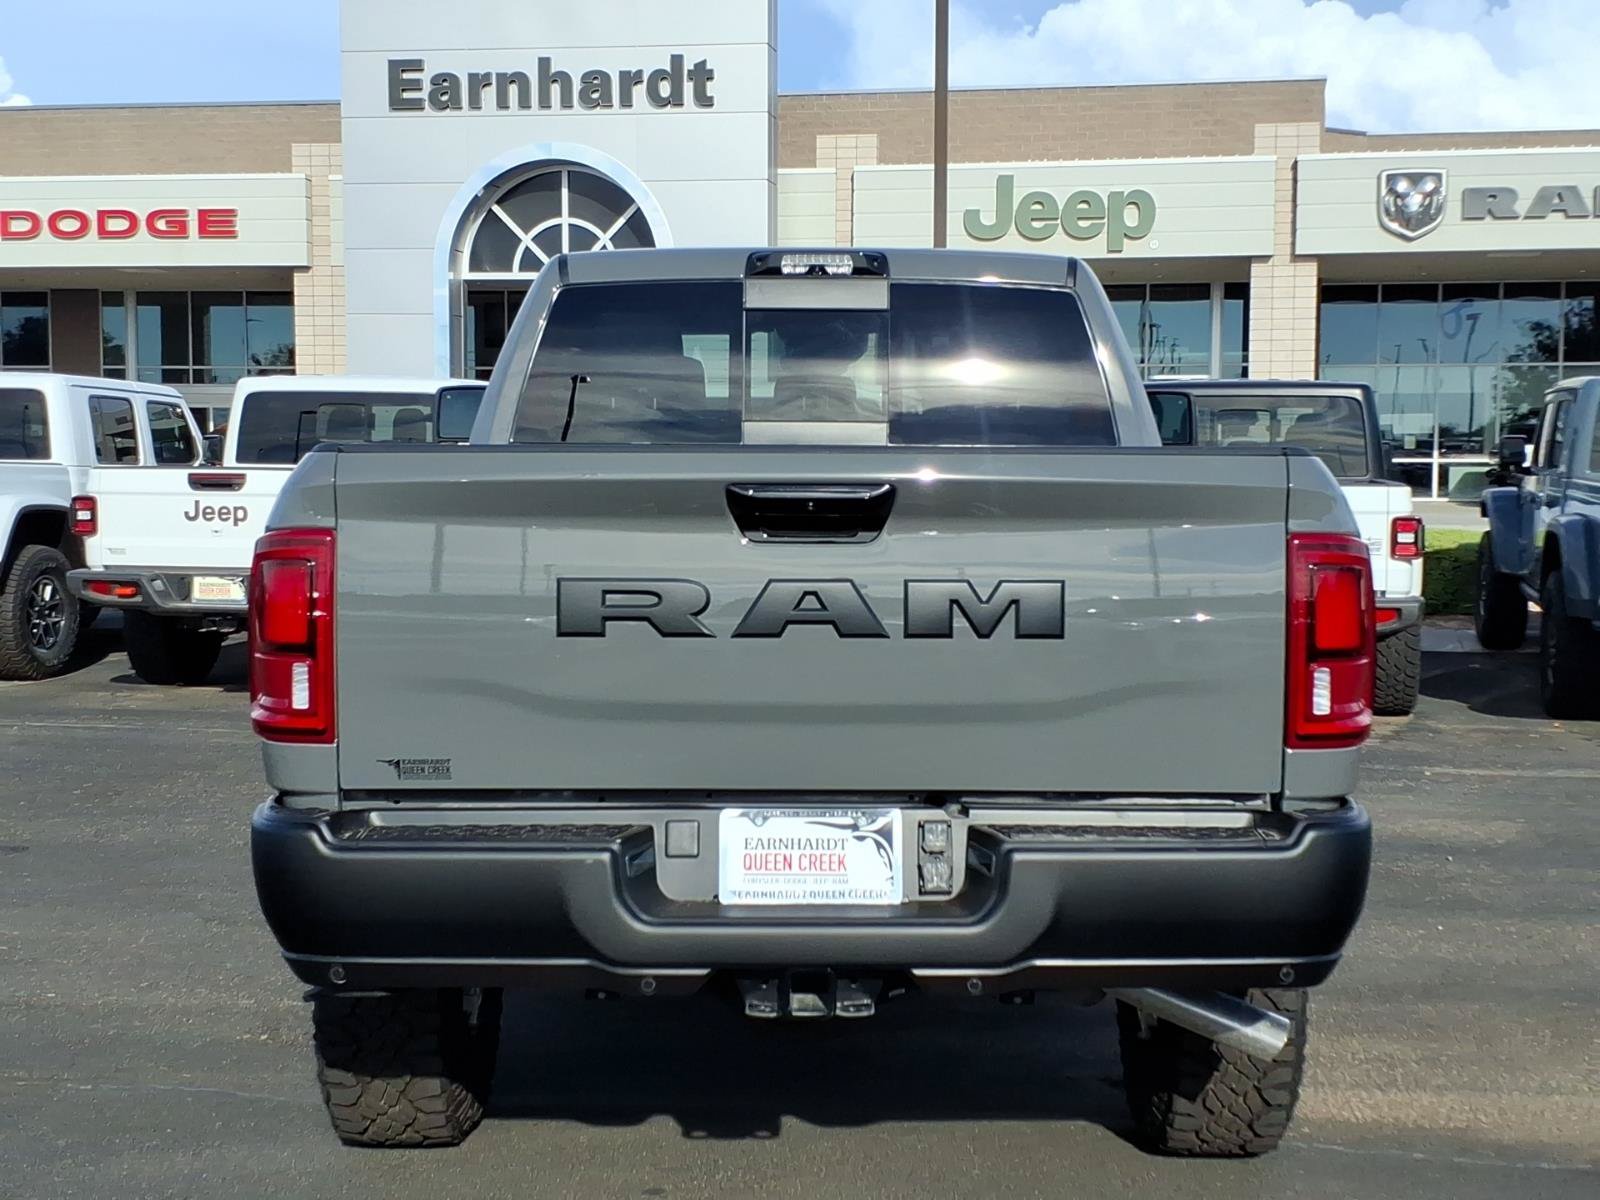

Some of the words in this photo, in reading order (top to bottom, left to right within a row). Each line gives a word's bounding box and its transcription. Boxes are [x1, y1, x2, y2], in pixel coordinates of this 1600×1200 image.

[388, 54, 714, 112] Earnhardt
[963, 174, 1156, 254] Jeep
[1462, 185, 1600, 221] RA
[0, 208, 239, 240] DODGE
[184, 500, 248, 526] Jeep
[556, 577, 1066, 639] RAM
[744, 837, 849, 851] EARNHARDT
[743, 853, 793, 872] QUEEN
[798, 853, 847, 872] CREEK
